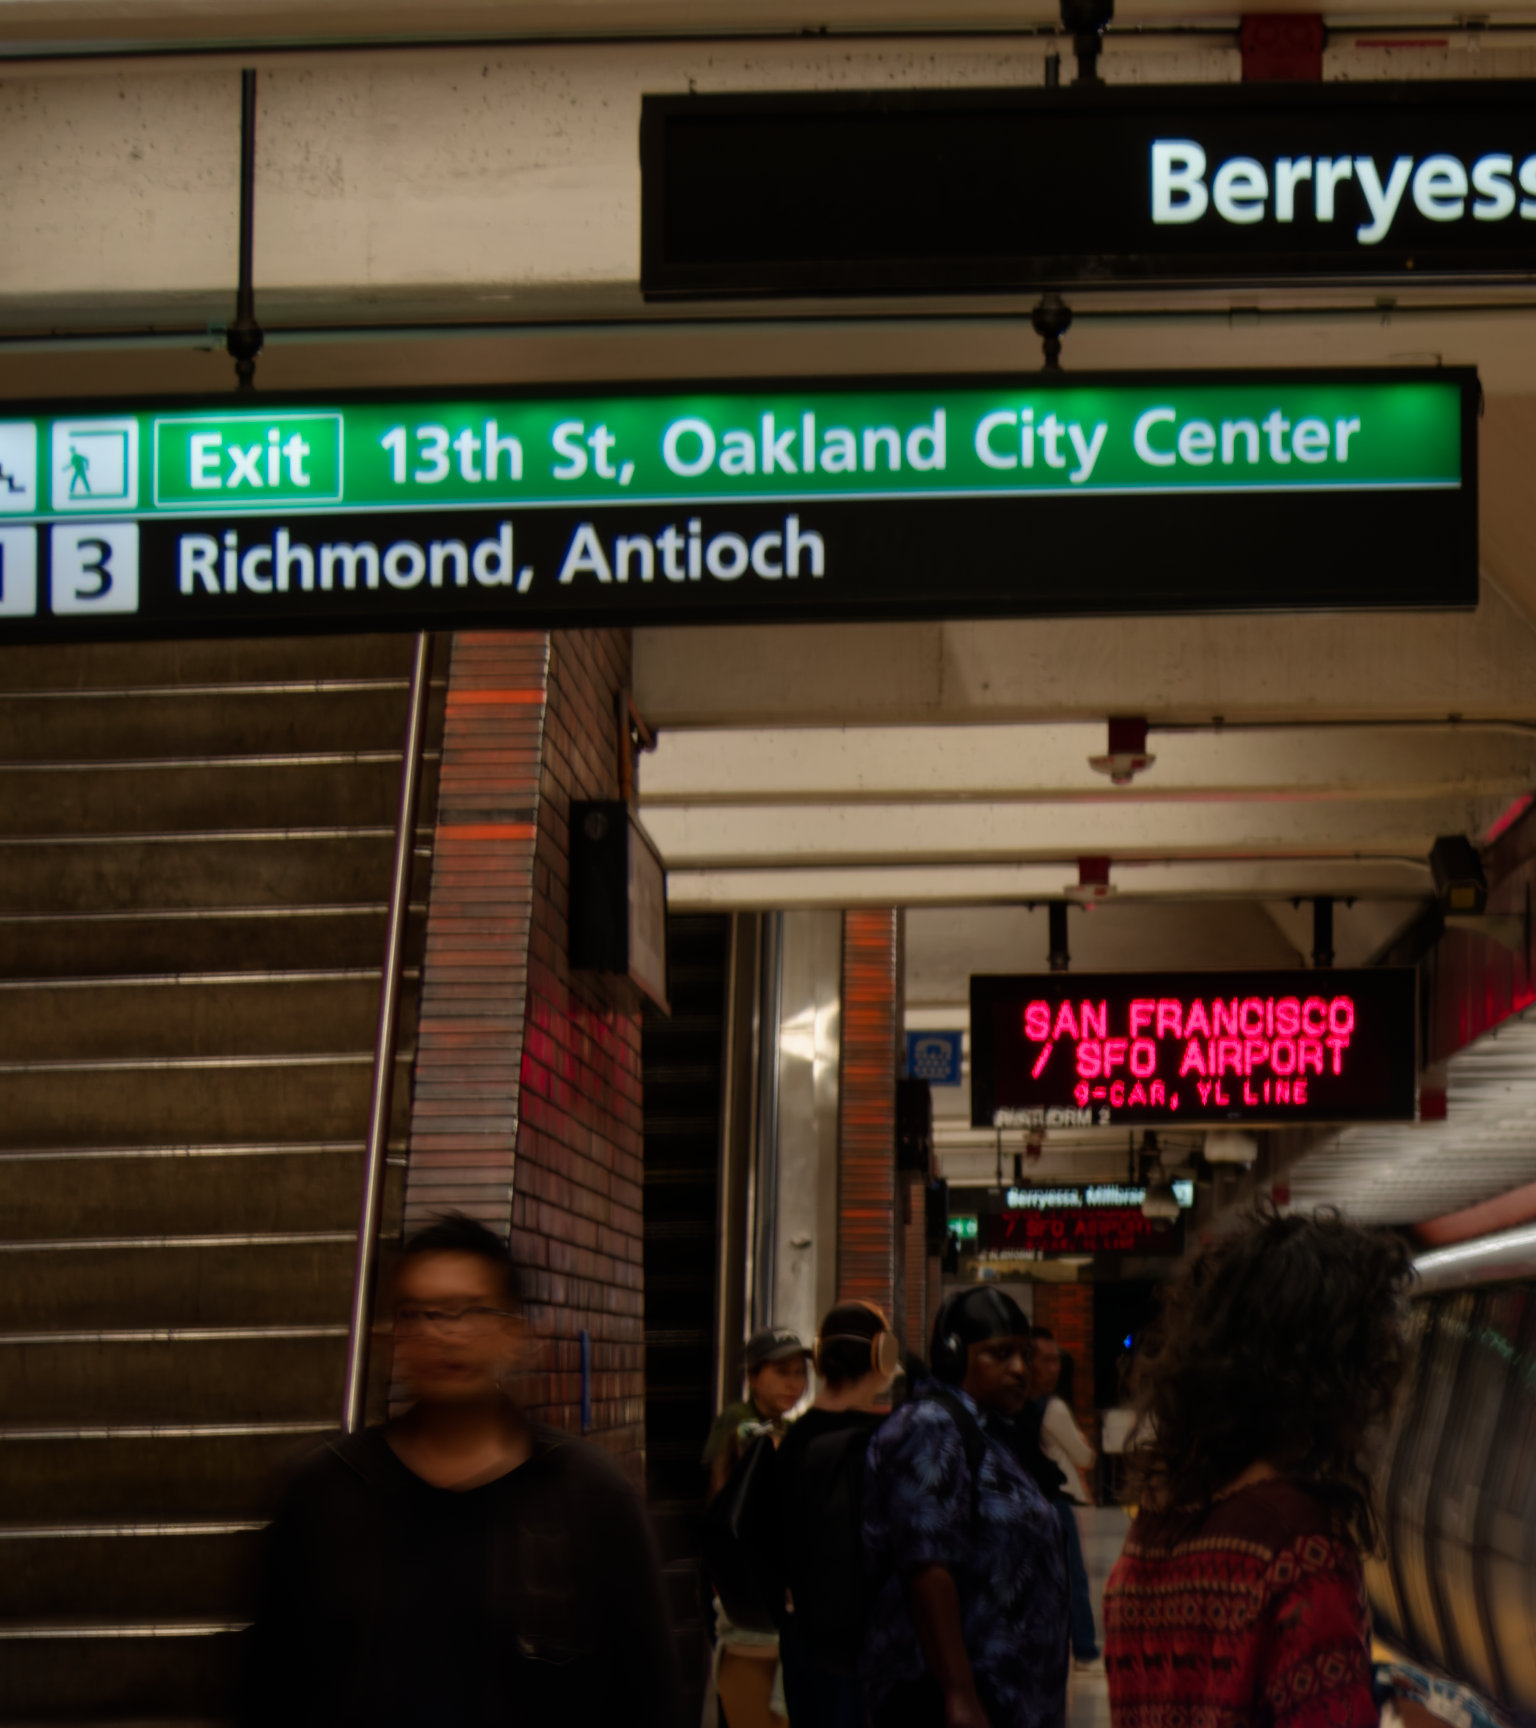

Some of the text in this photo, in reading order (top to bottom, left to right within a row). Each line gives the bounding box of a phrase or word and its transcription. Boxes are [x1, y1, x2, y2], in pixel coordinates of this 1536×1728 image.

[189, 408, 1362, 490] Exit 13th St, Oakland City Center
[75, 517, 826, 601] 3 Richmond, Antioch
[1024, 996, 1355, 1042] SAN FRANCISCO
[1031, 1034, 1351, 1079] / SFO AIRPORT
[1196, 1078, 1231, 1106] YL
[1243, 1077, 1308, 1105] LINE
